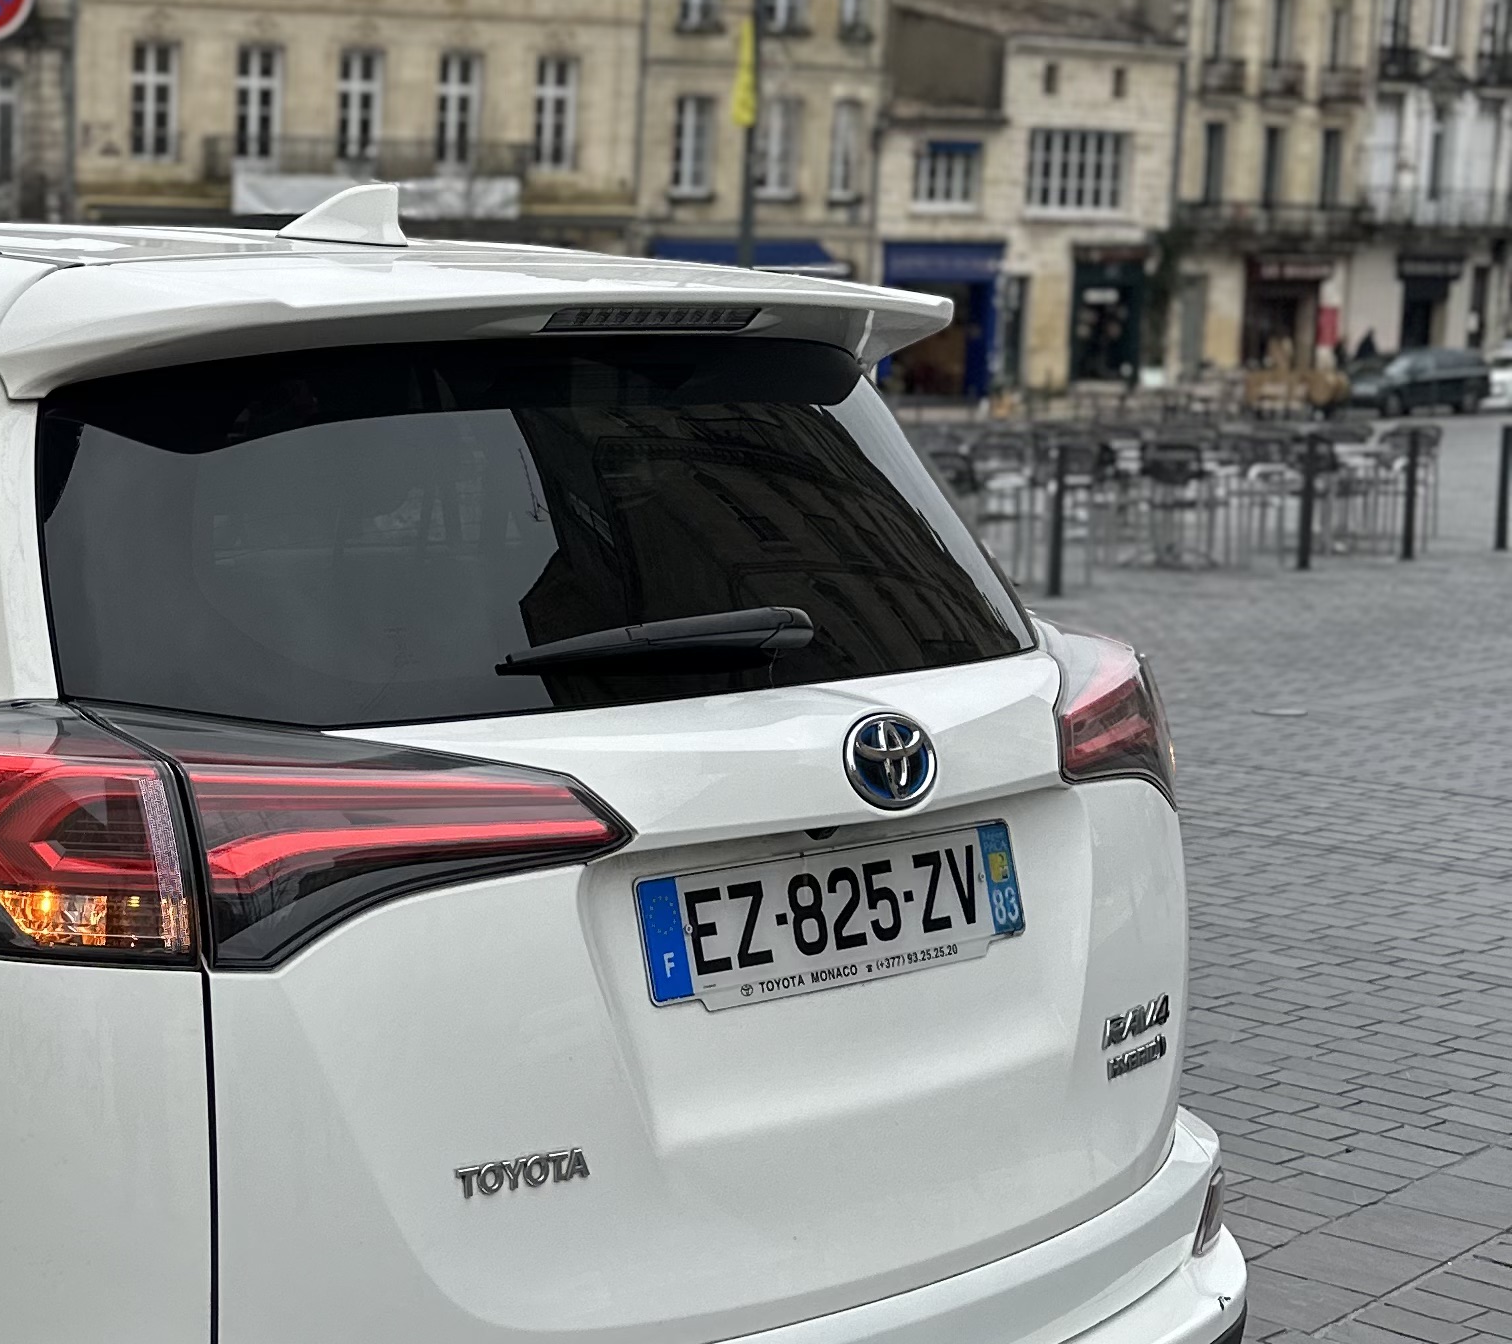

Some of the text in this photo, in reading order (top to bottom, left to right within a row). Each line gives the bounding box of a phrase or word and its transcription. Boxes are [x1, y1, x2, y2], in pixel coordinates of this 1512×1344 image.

[684, 844, 978, 976] EZ-825-ZV
[992, 886, 1020, 925] 83
[662, 952, 676, 979] F
[759, 943, 959, 994] TOYOTA MONACO (+377) 93.25.25.20
[1101, 992, 1171, 1051] RAV4
[454, 1146, 591, 1199] TOYOTA
